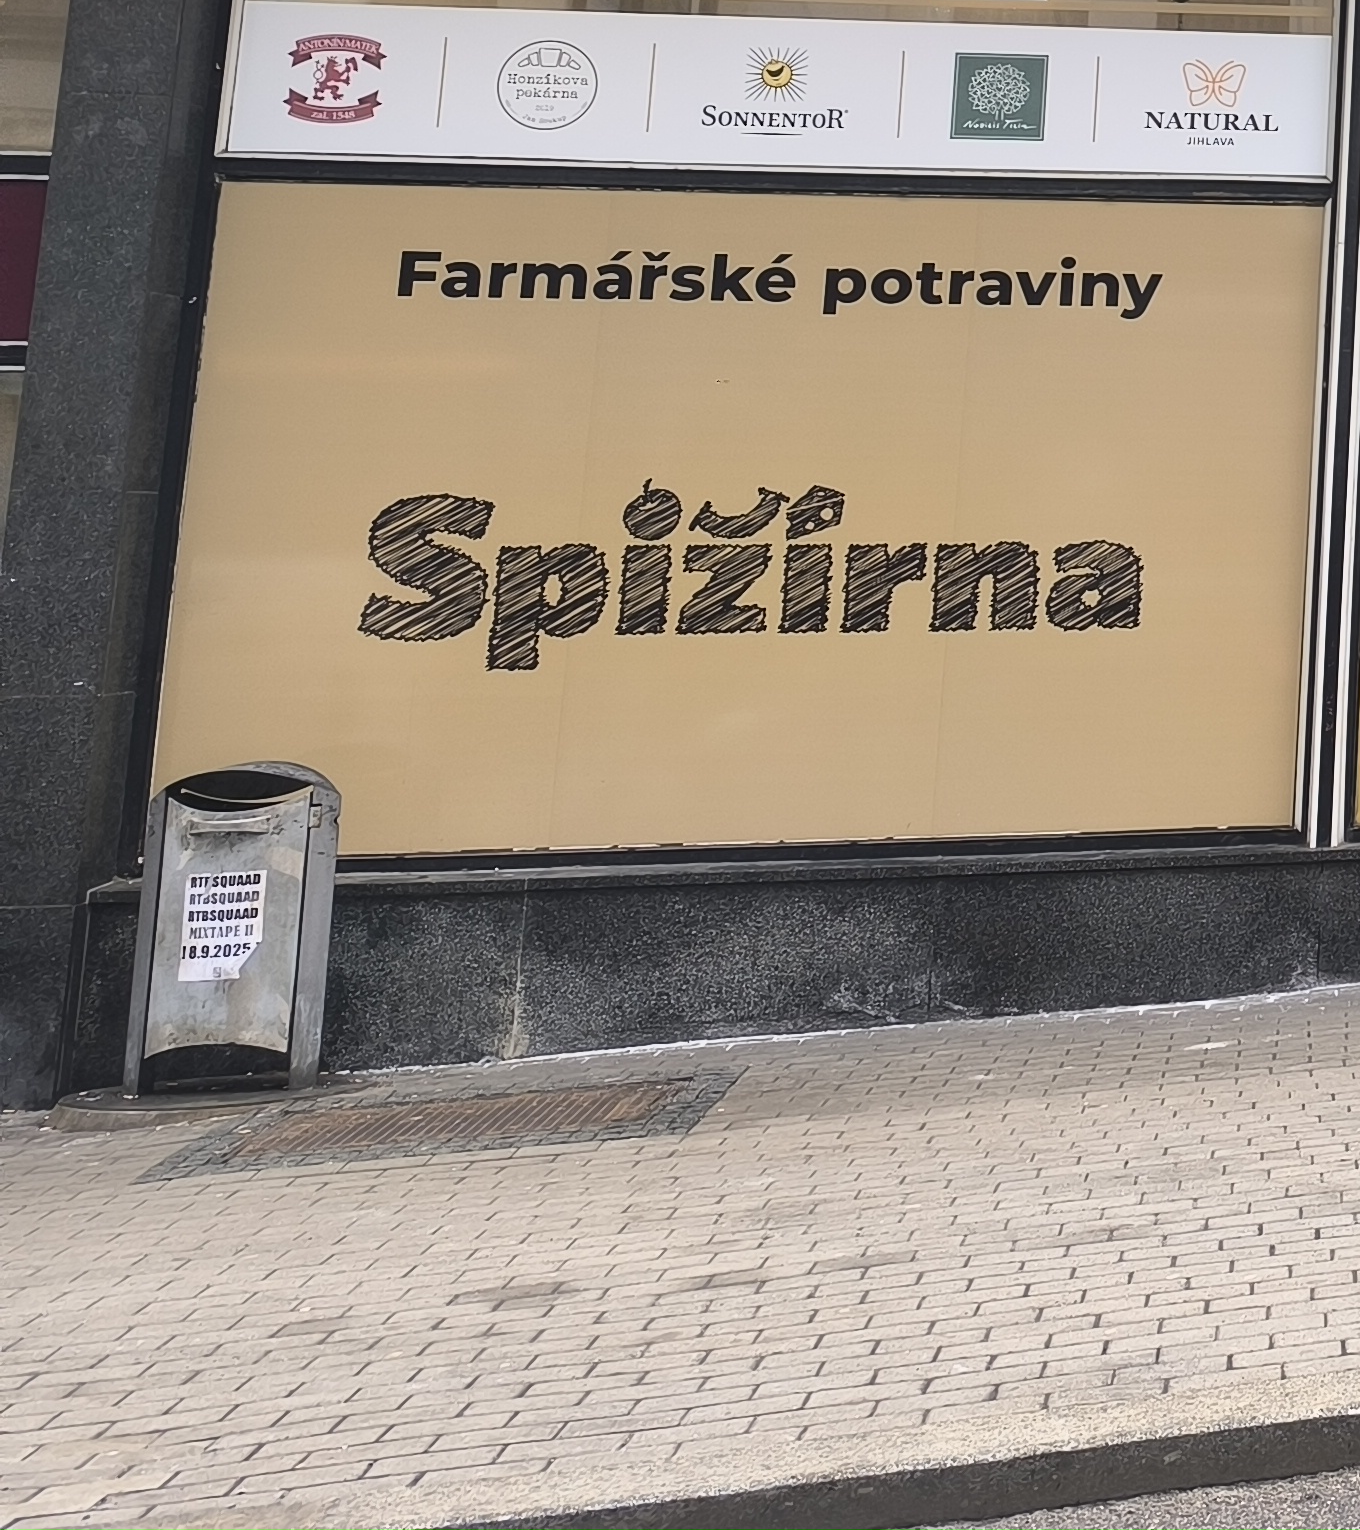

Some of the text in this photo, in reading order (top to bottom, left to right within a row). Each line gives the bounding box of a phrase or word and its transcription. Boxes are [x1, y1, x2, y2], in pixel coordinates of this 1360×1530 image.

[507, 73, 589, 86] Honzíkova
[516, 87, 578, 100] pekárna
[1143, 111, 1279, 132] NATURAL
[1186, 136, 1235, 146] JIHLAVA
[396, 249, 1164, 320] Farmářské potraviny
[357, 478, 1146, 672] Spižírna
[187, 907, 259, 923] RTBSQUAAD
[188, 923, 254, 940] MIXTAPE II
[181, 942, 252, 960] 18.9.2025
